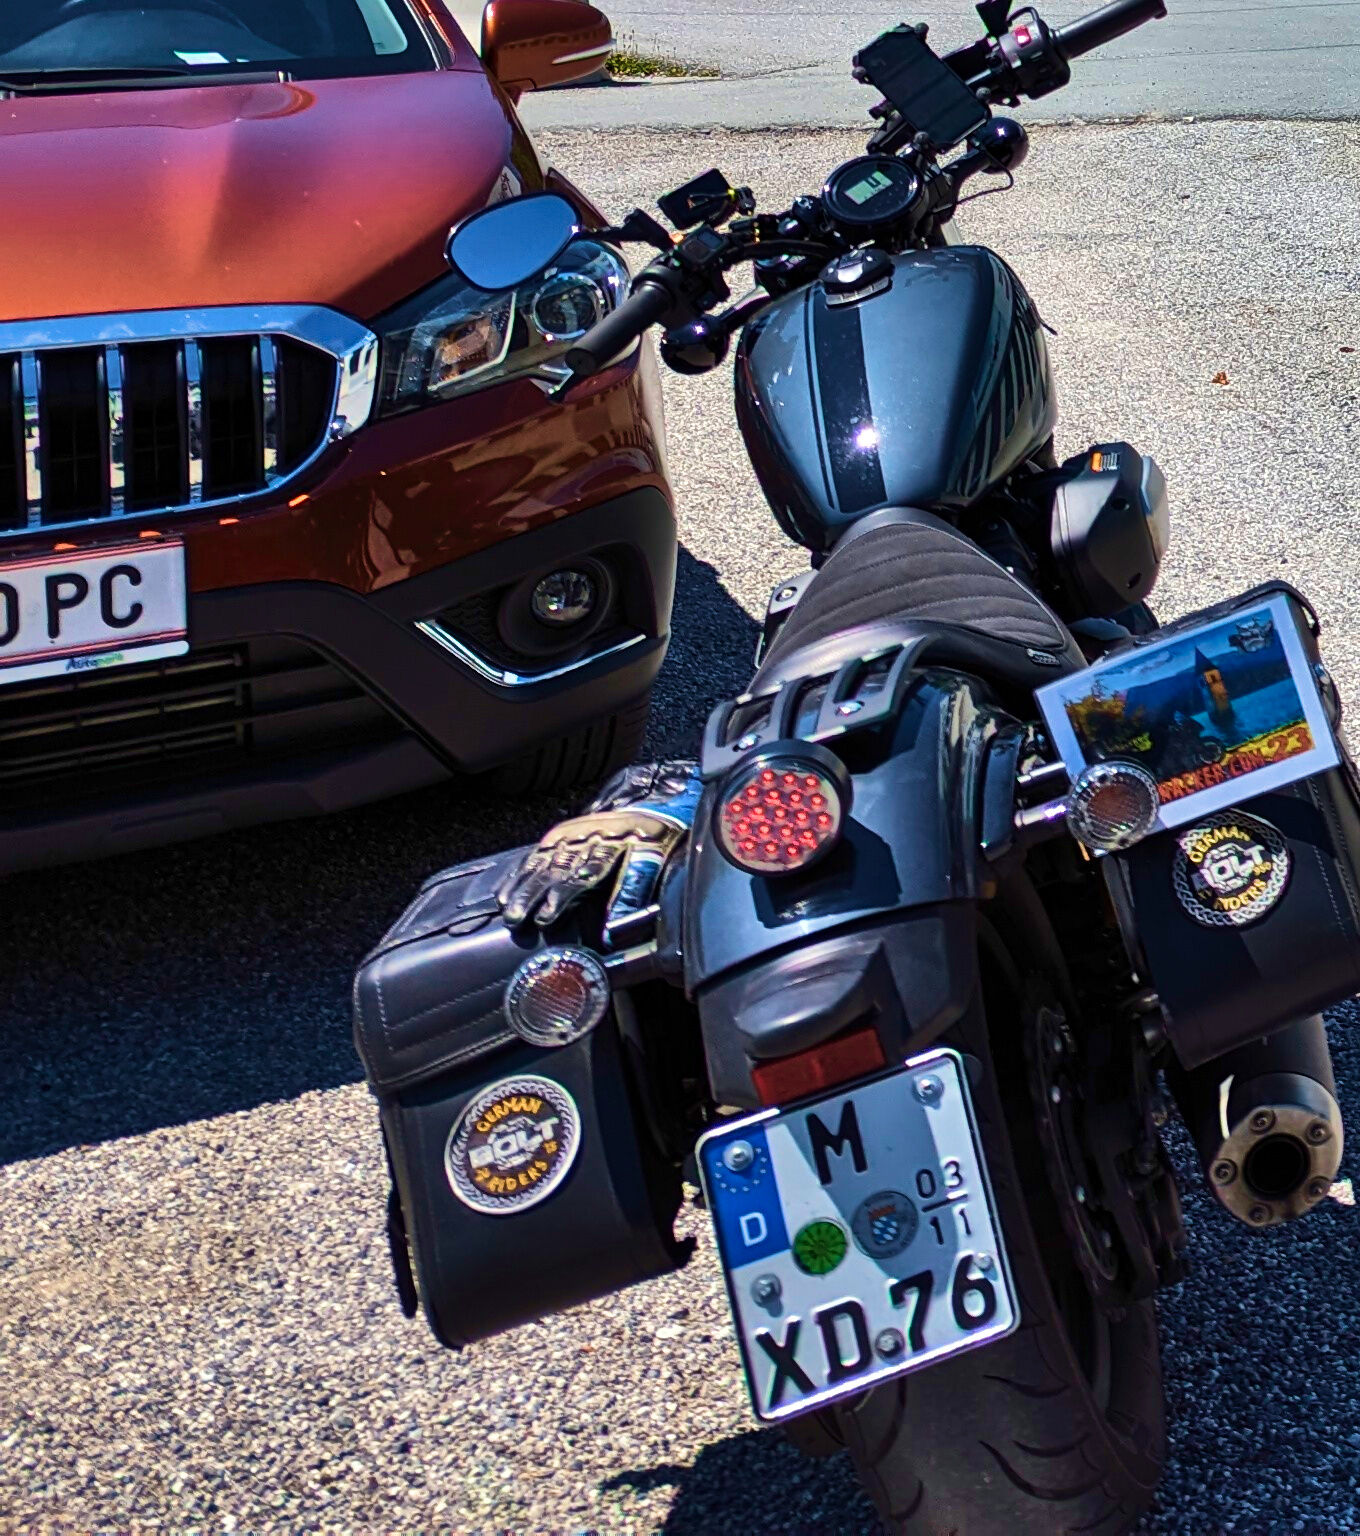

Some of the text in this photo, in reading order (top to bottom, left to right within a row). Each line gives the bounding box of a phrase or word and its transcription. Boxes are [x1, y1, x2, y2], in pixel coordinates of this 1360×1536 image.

[476, 1097, 543, 1132] GERMAN
[805, 1100, 868, 1185] M
[487, 1161, 548, 1193] RIDERS
[916, 1159, 964, 1199] 03
[739, 1212, 768, 1247] D
[928, 1206, 973, 1246] 11
[755, 1253, 997, 1409] XD 76
